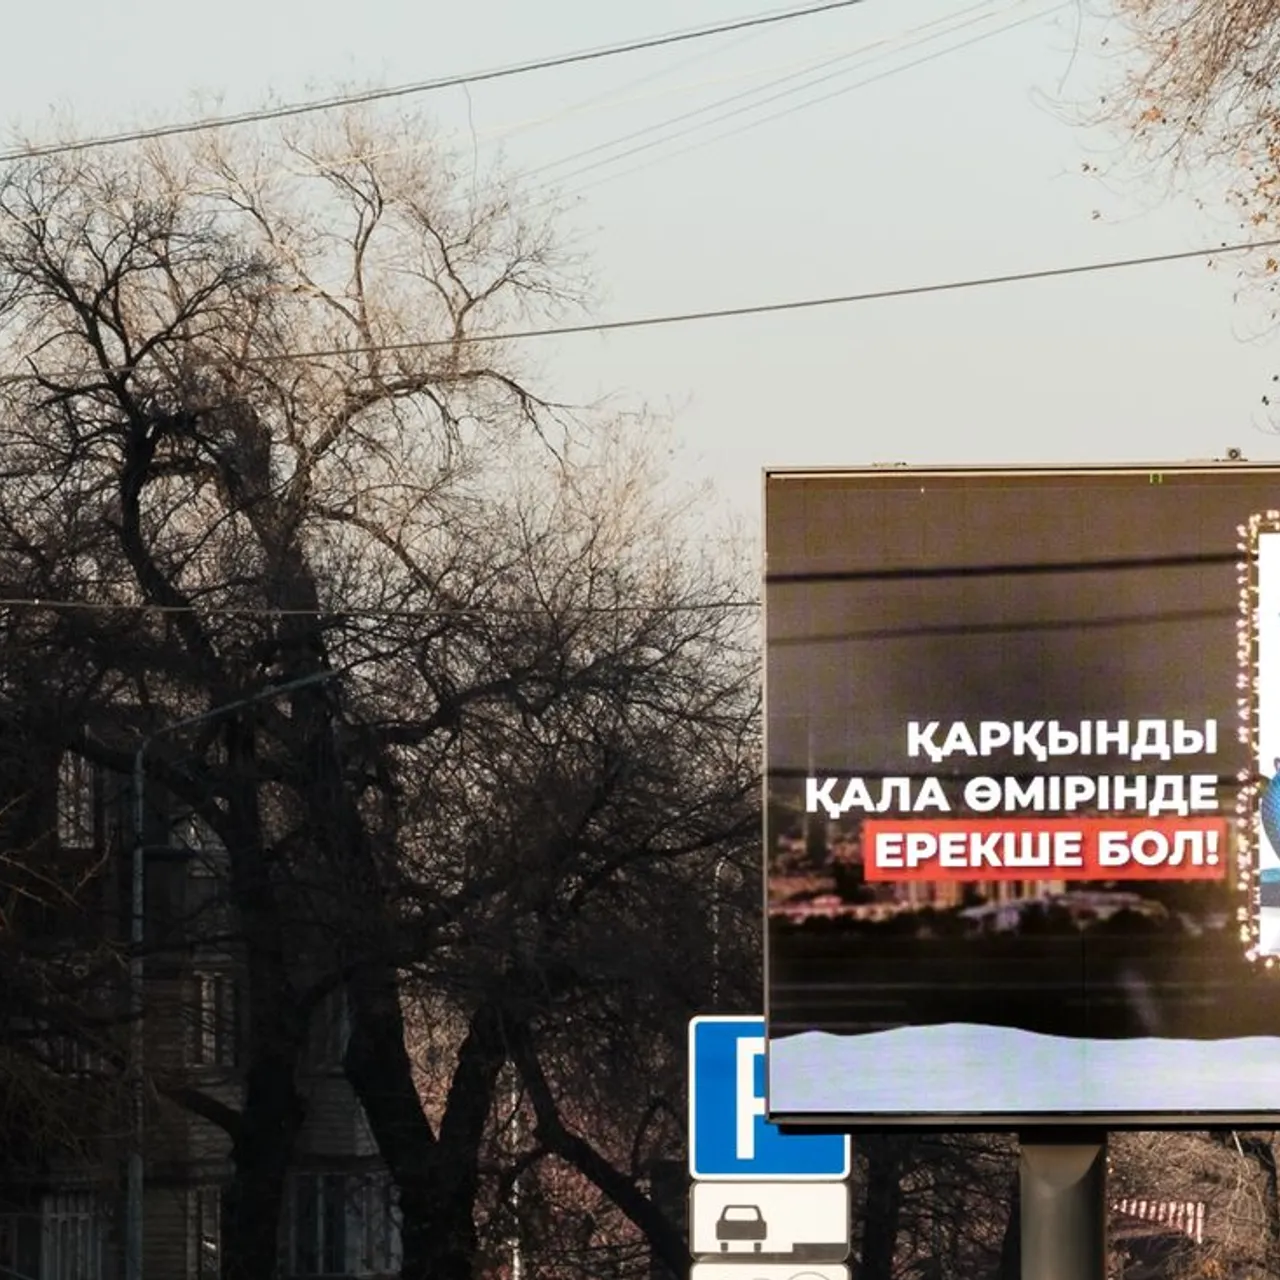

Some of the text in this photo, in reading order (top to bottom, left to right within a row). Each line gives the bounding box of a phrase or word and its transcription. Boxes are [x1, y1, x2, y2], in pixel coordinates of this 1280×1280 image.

[907, 720, 1218, 762] ҚАРҚЫНДЫ
[806, 775, 1219, 819] ҚАЛА ӨМІРІНДЕ
[875, 830, 1219, 868] ЕРЕКШЕ БОЛ!
